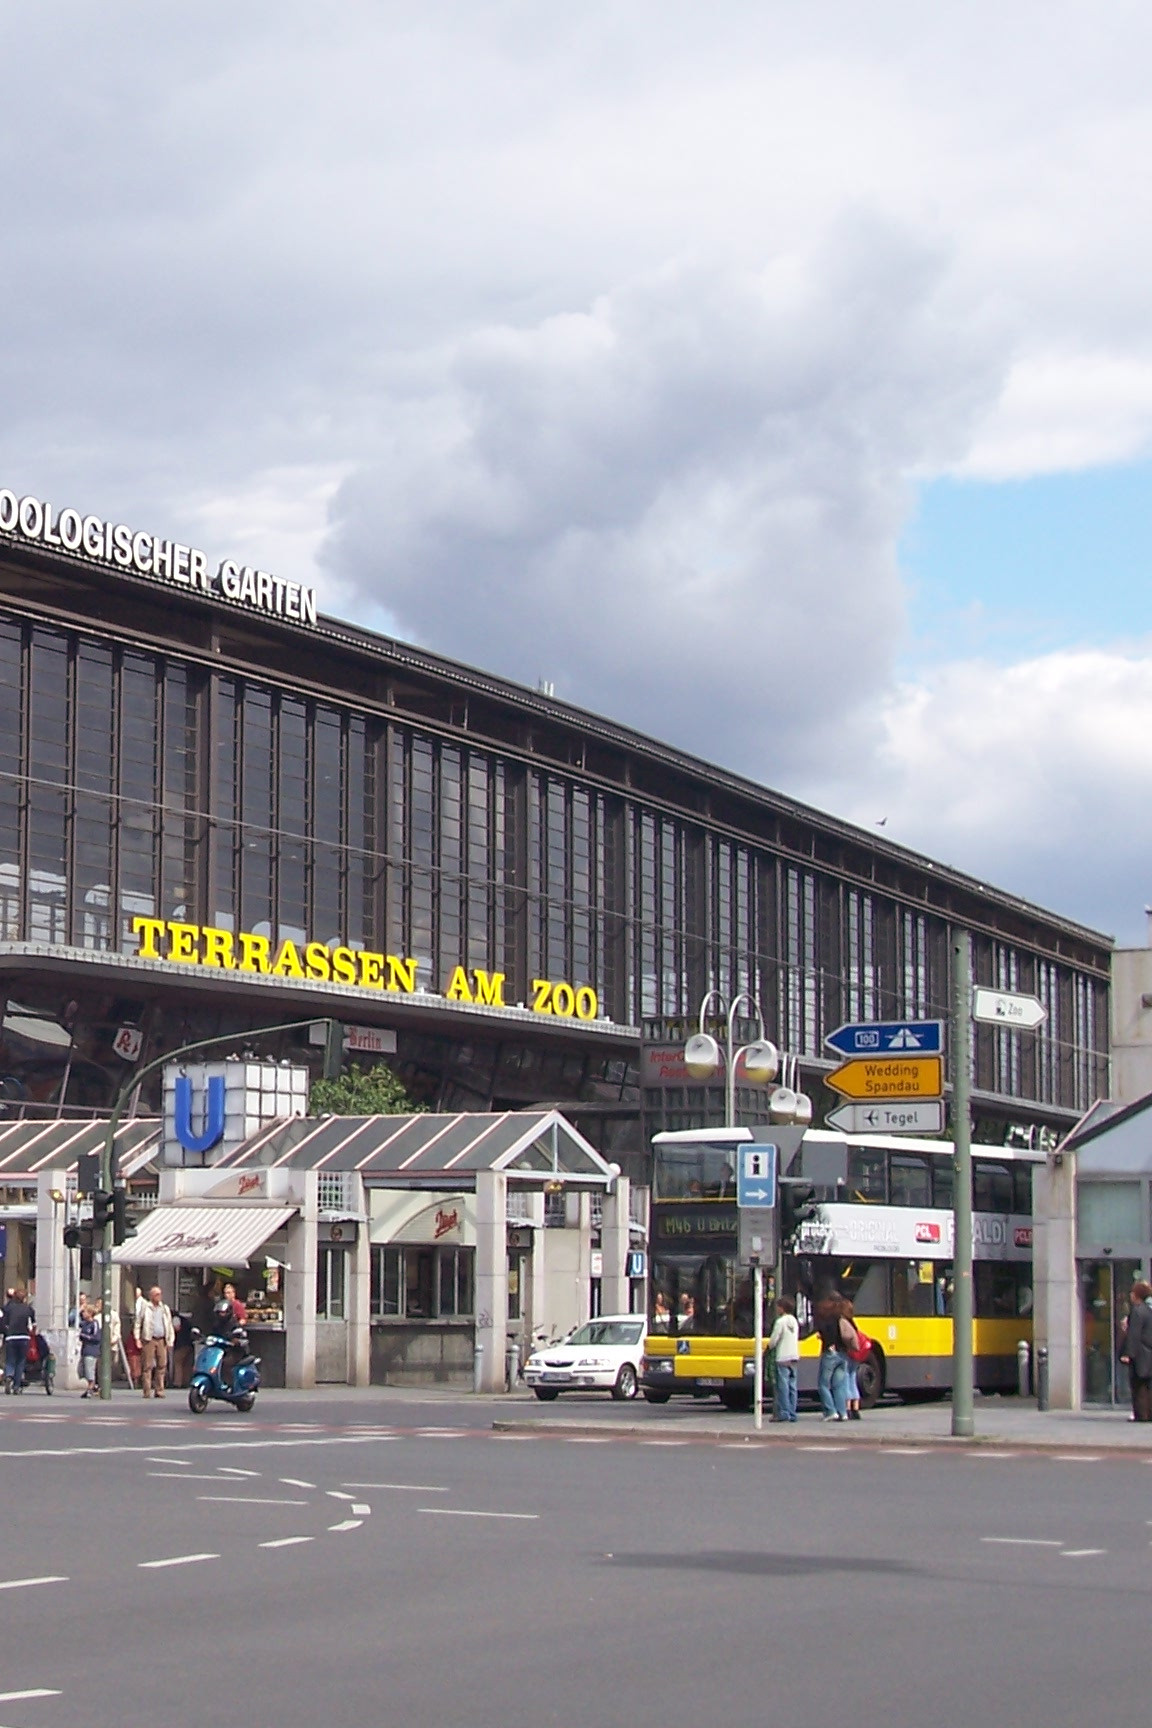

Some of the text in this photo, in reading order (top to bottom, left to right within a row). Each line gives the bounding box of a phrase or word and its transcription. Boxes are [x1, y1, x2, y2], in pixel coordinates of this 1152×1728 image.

[221, 559, 317, 625] GARTEN
[133, 917, 598, 1021] TERRASSEN AM ZOO
[1007, 1003, 1024, 1016] Zoo
[858, 1033, 877, 1045] 100
[864, 1064, 919, 1078] Wedding
[865, 1080, 920, 1093] Spandau
[174, 1076, 225, 1152] U
[884, 1110, 919, 1126] Tegel
[632, 1253, 643, 1274] U
